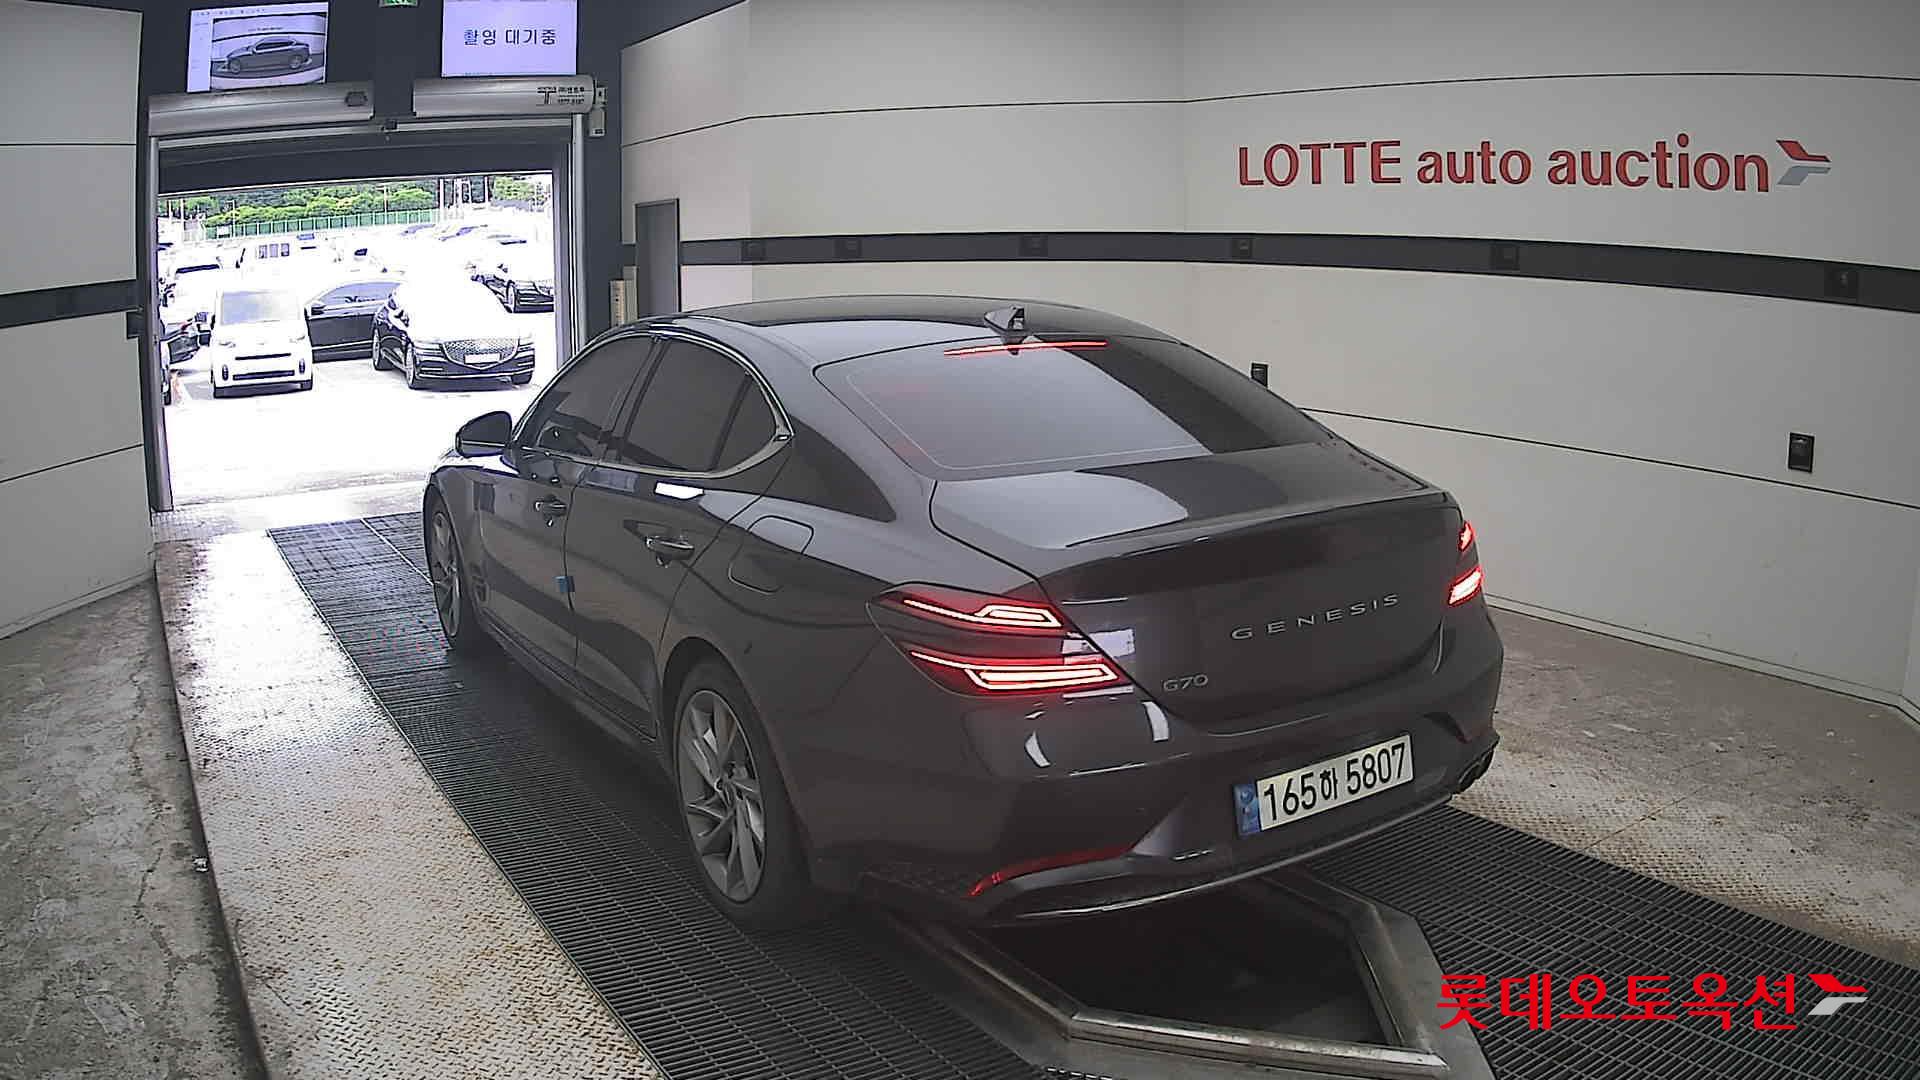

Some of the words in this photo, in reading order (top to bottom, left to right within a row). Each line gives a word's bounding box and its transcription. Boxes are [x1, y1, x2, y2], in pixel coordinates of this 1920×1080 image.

[505, 28, 556, 46] 대기중
[1238, 140, 1401, 187] LOTTE
[1416, 141, 1532, 185] auto
[1547, 133, 1769, 192] auction
[1231, 594, 1399, 640] GENESIS
[1162, 673, 1209, 692] G70
[1263, 768, 1338, 821] 165하
[1346, 742, 1405, 795] 5807
